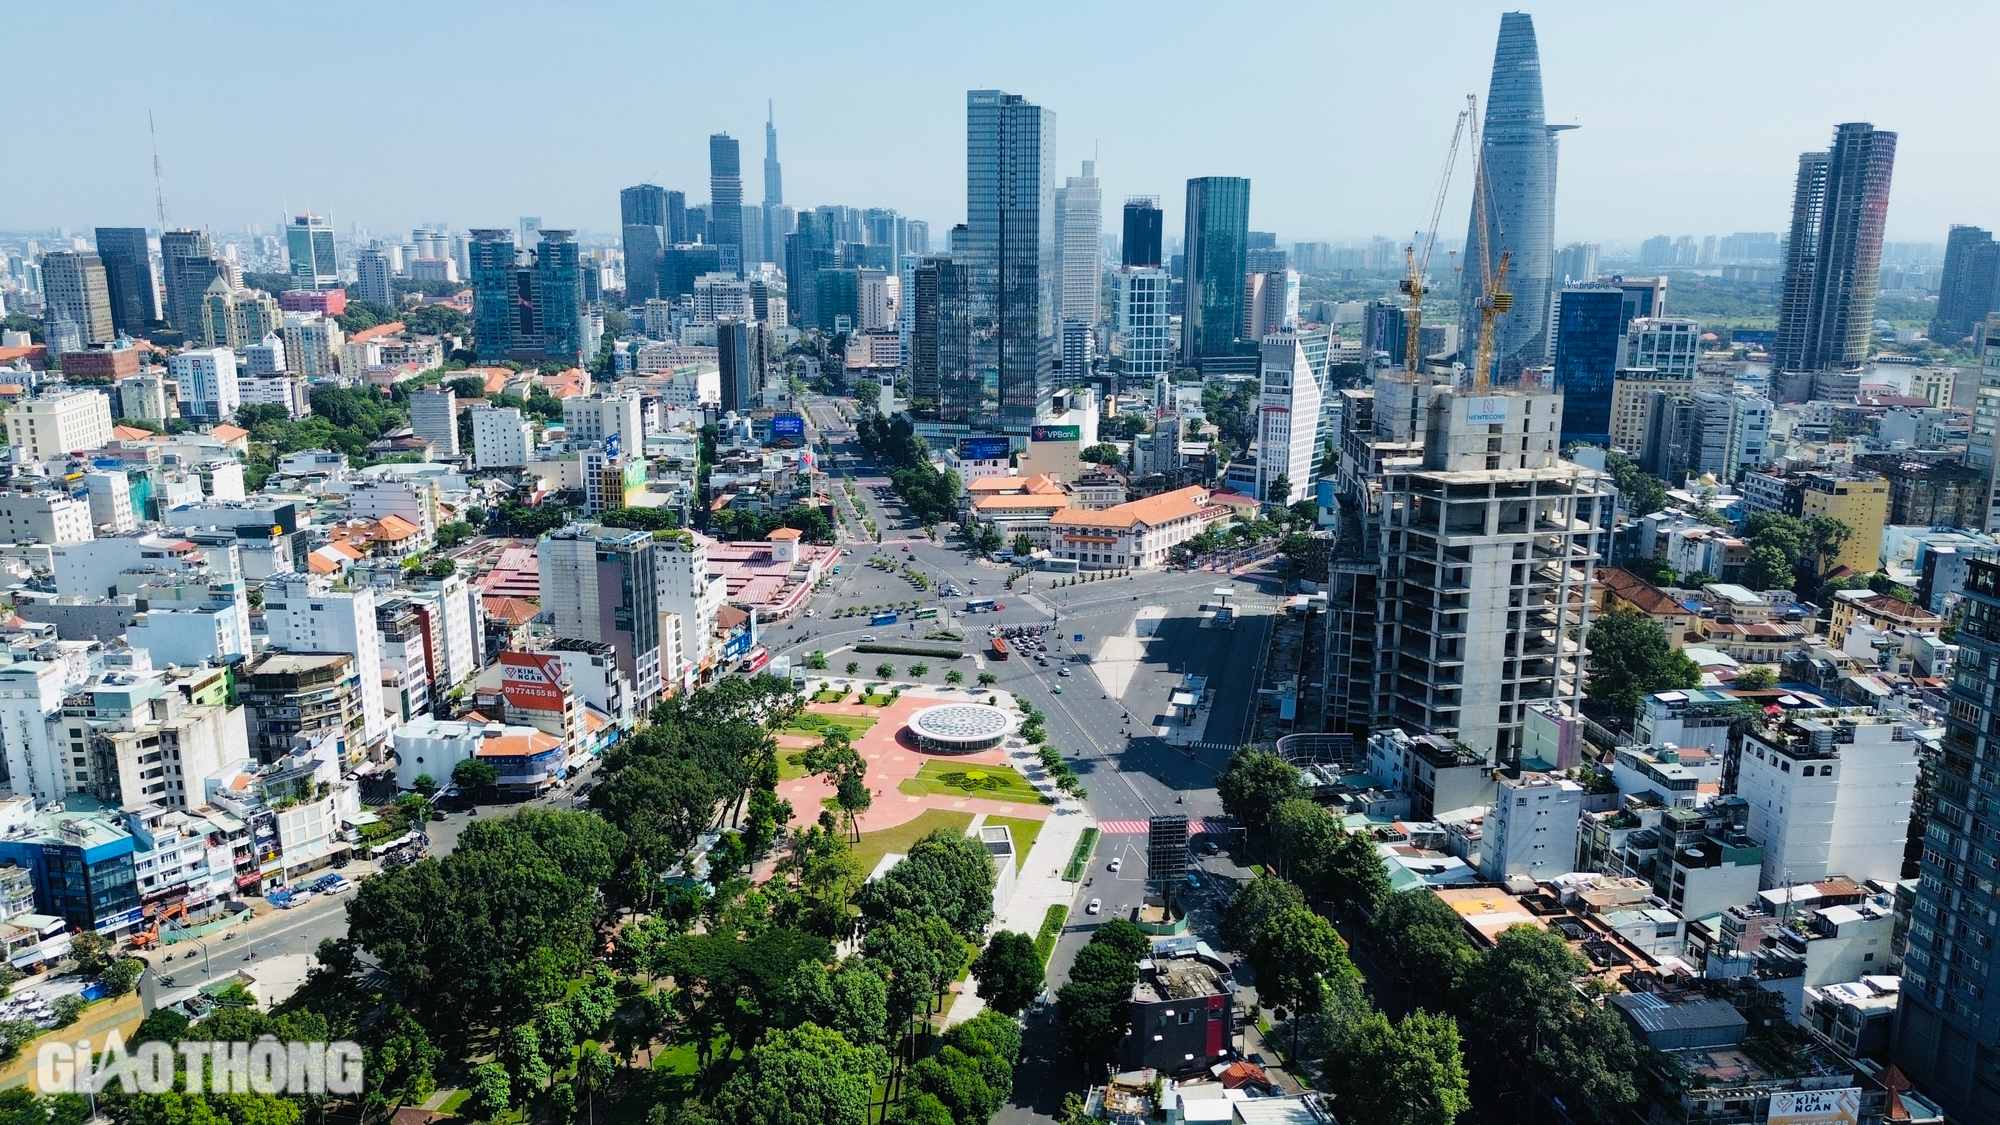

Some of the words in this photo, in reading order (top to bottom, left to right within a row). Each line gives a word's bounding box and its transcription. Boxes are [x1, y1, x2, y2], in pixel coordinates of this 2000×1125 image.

[1566, 280, 1610, 289] VietinBank
[1047, 430, 1076, 438] VPBank
[106, 914, 129, 925] BVBank
[1796, 1096, 1820, 1104] KIM
[1795, 1104, 1831, 1112] NGAN
